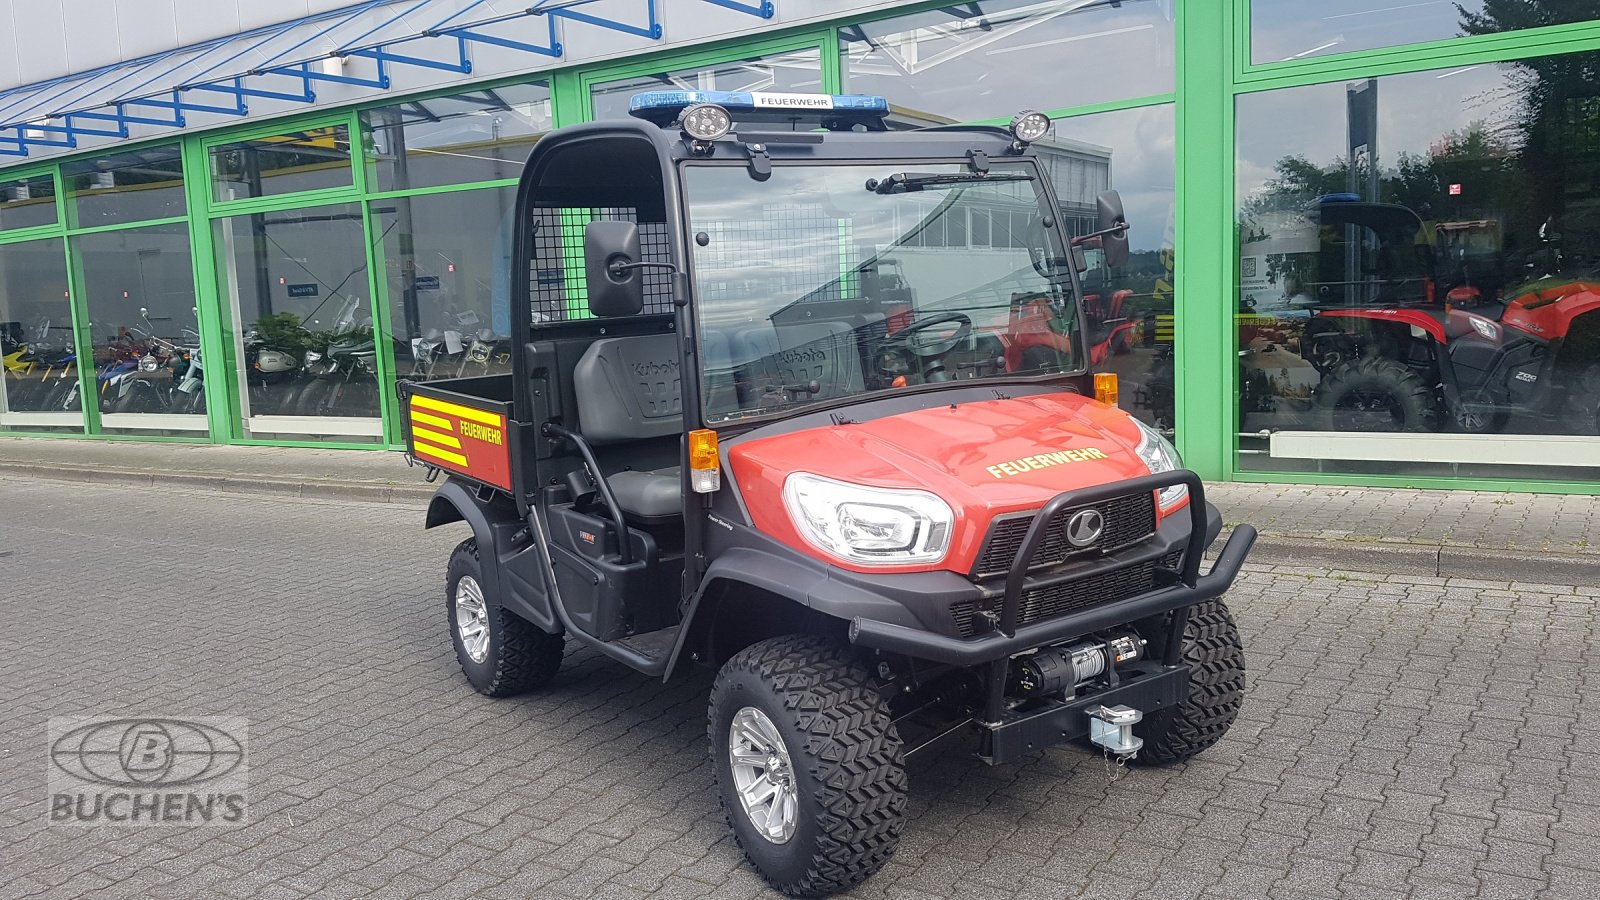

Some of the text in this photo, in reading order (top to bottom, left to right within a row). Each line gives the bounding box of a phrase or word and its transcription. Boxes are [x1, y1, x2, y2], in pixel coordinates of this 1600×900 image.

[761, 98, 828, 106] FEUERWEHR
[460, 420, 502, 446] FEUERWEHR
[985, 447, 1109, 479] FEUERWEHR
